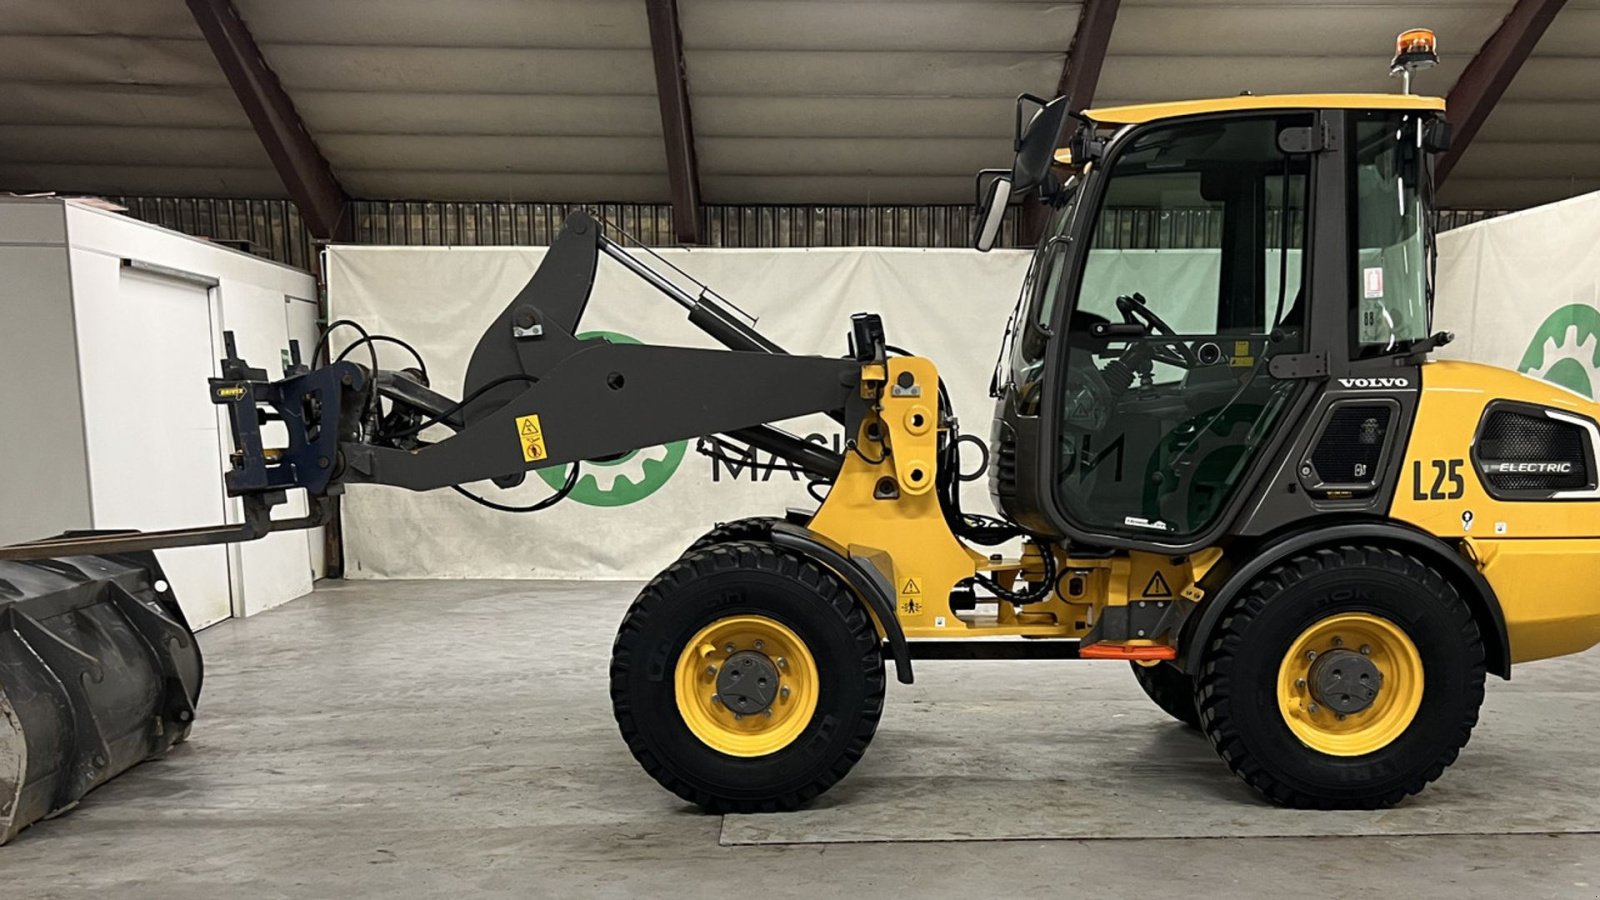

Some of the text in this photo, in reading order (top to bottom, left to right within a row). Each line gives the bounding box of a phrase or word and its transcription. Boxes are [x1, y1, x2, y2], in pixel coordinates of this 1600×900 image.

[1337, 378, 1409, 388] VOLVO
[1499, 462, 1571, 473] ELECTRIC
[1413, 459, 1464, 501] L25
